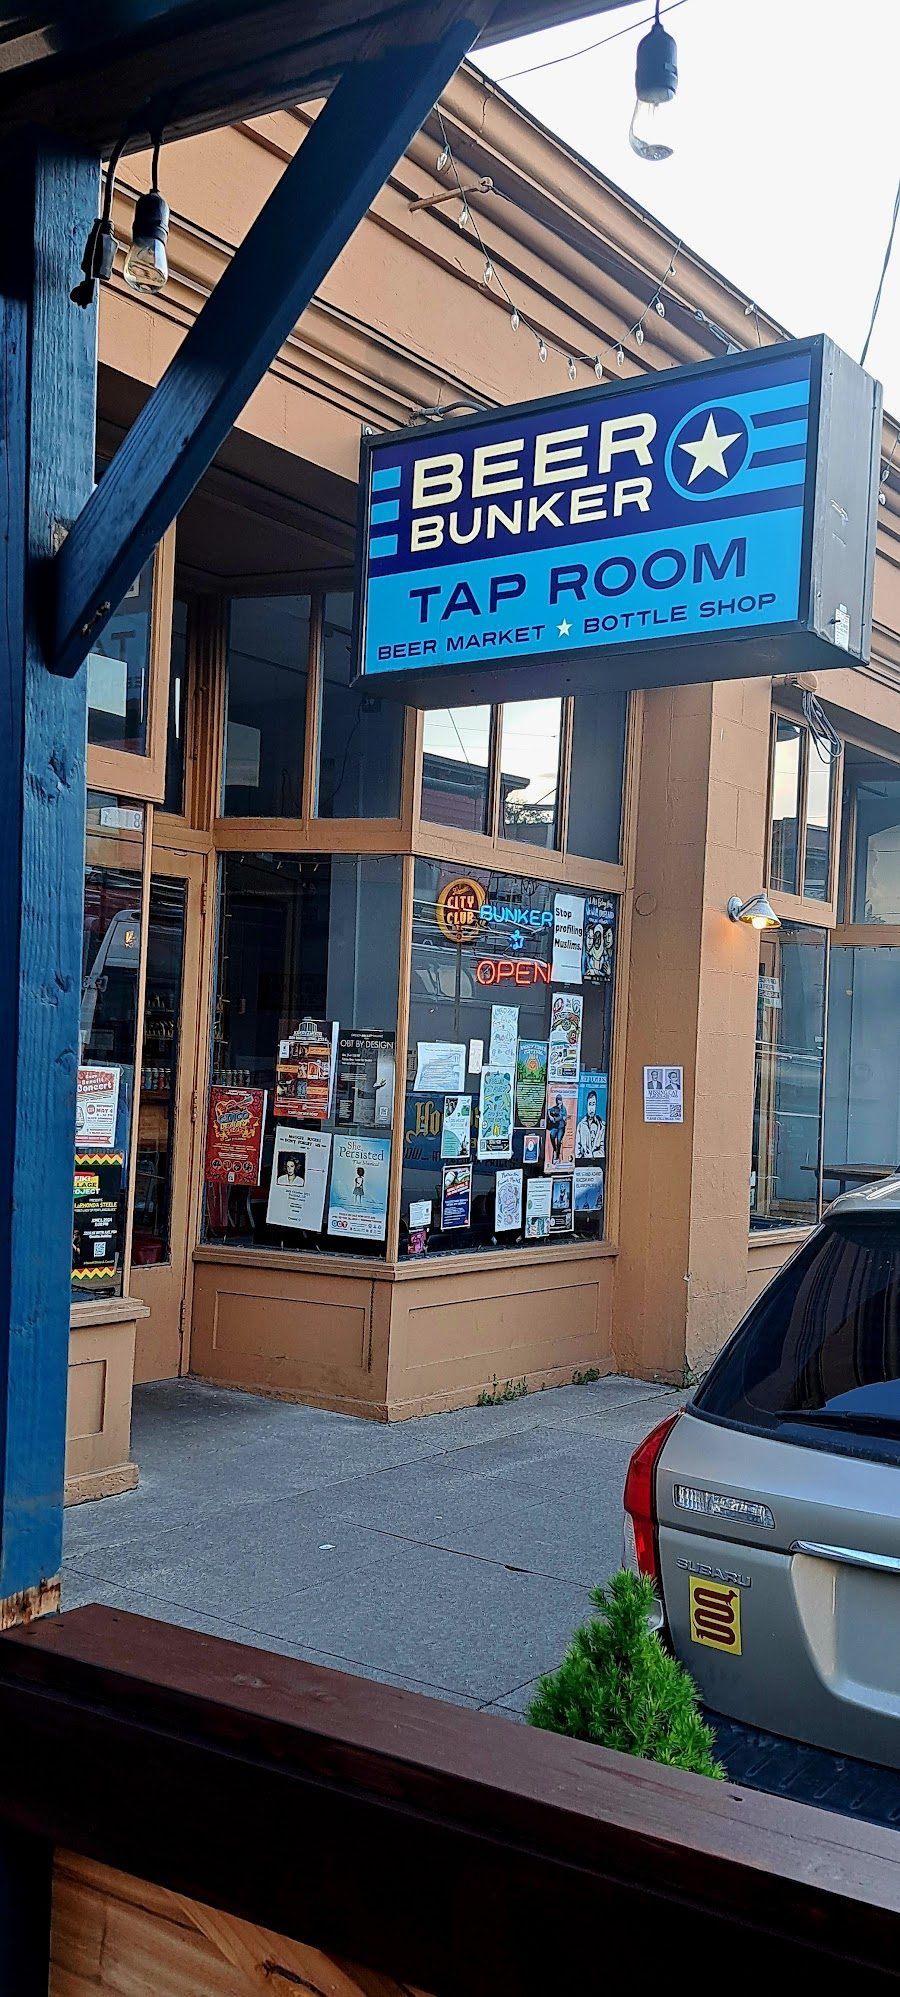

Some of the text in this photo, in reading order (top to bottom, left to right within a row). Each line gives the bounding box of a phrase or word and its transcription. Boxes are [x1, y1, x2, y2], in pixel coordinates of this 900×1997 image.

[411, 412, 658, 511] BEER
[410, 476, 653, 553] BUNKER
[408, 536, 747, 624] TAP ROOM
[377, 592, 778, 661] BEER MARKET BOTTLE SHOP
[447, 895, 475, 910] CITY
[446, 911, 475, 926] CLUB
[480, 904, 554, 927] BUNKER
[555, 907, 573, 919] Stop
[555, 924, 583, 937] profiling
[554, 938, 582, 950] Muslims.
[476, 959, 550, 985] OPEN
[340, 1040, 394, 1049] OBT BY DESIGN
[339, 1146, 385, 1161] Persisted
[347, 1141, 362, 1151] She
[675, 1557, 753, 1588] SUBARU
